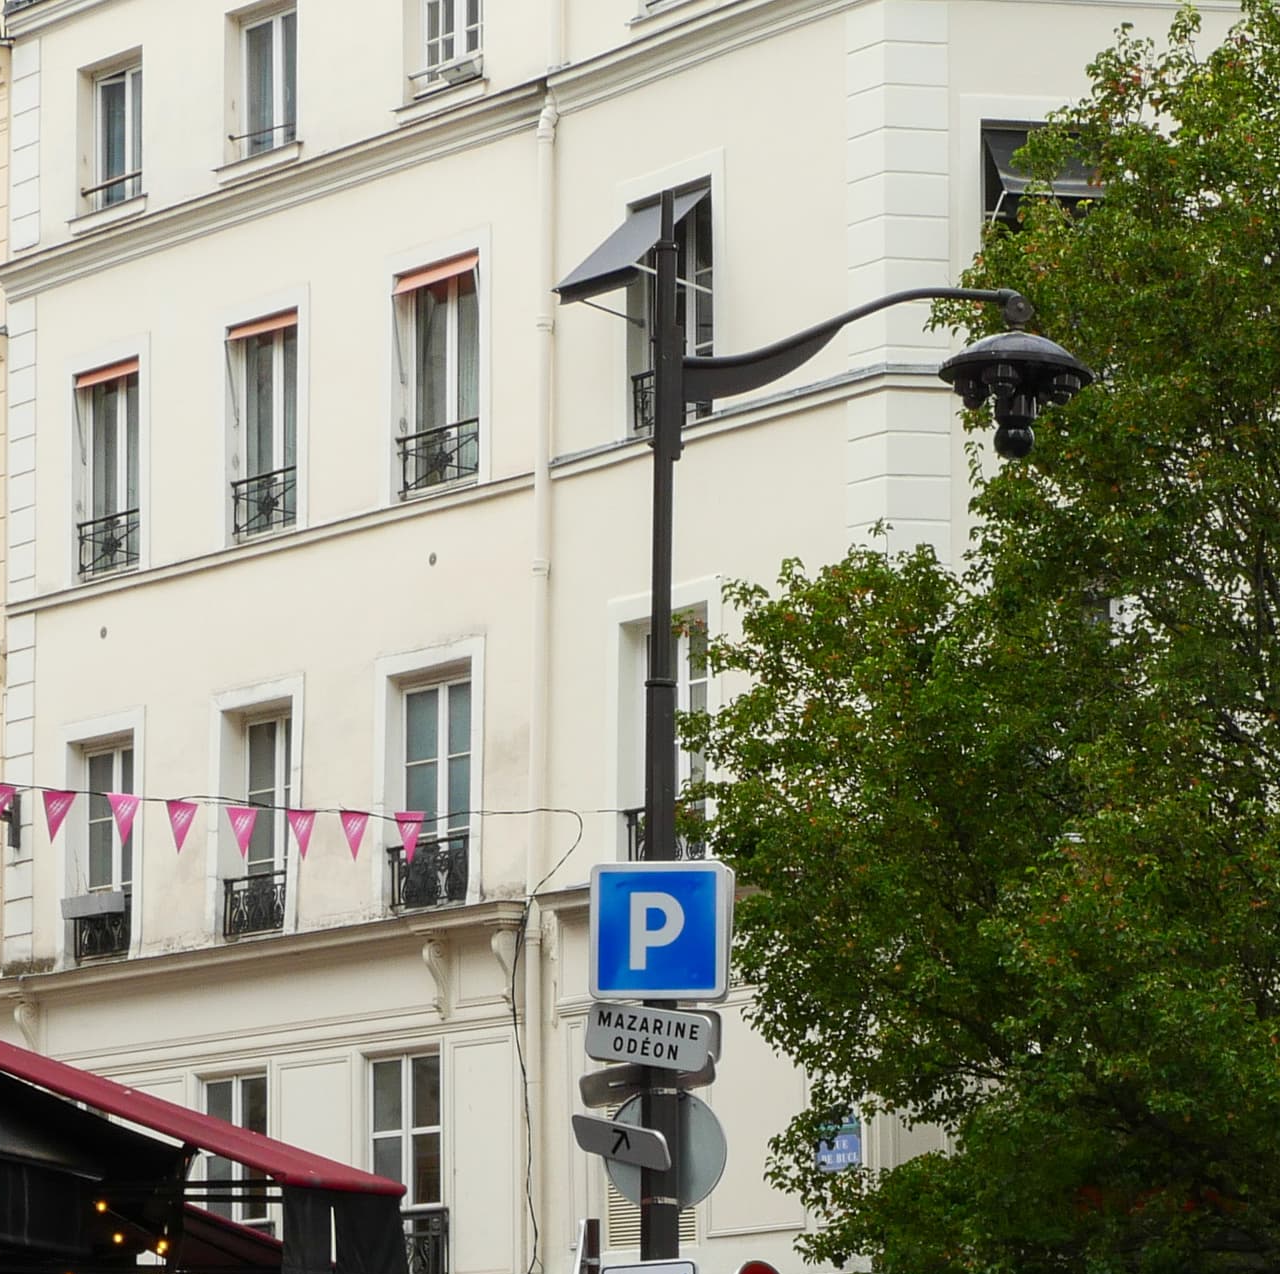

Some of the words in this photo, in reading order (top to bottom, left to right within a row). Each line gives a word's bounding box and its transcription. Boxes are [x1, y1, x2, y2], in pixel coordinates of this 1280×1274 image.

[629, 891, 685, 971] P
[597, 1010, 700, 1041] MAZARINE
[612, 1035, 680, 1061] ODÉON
